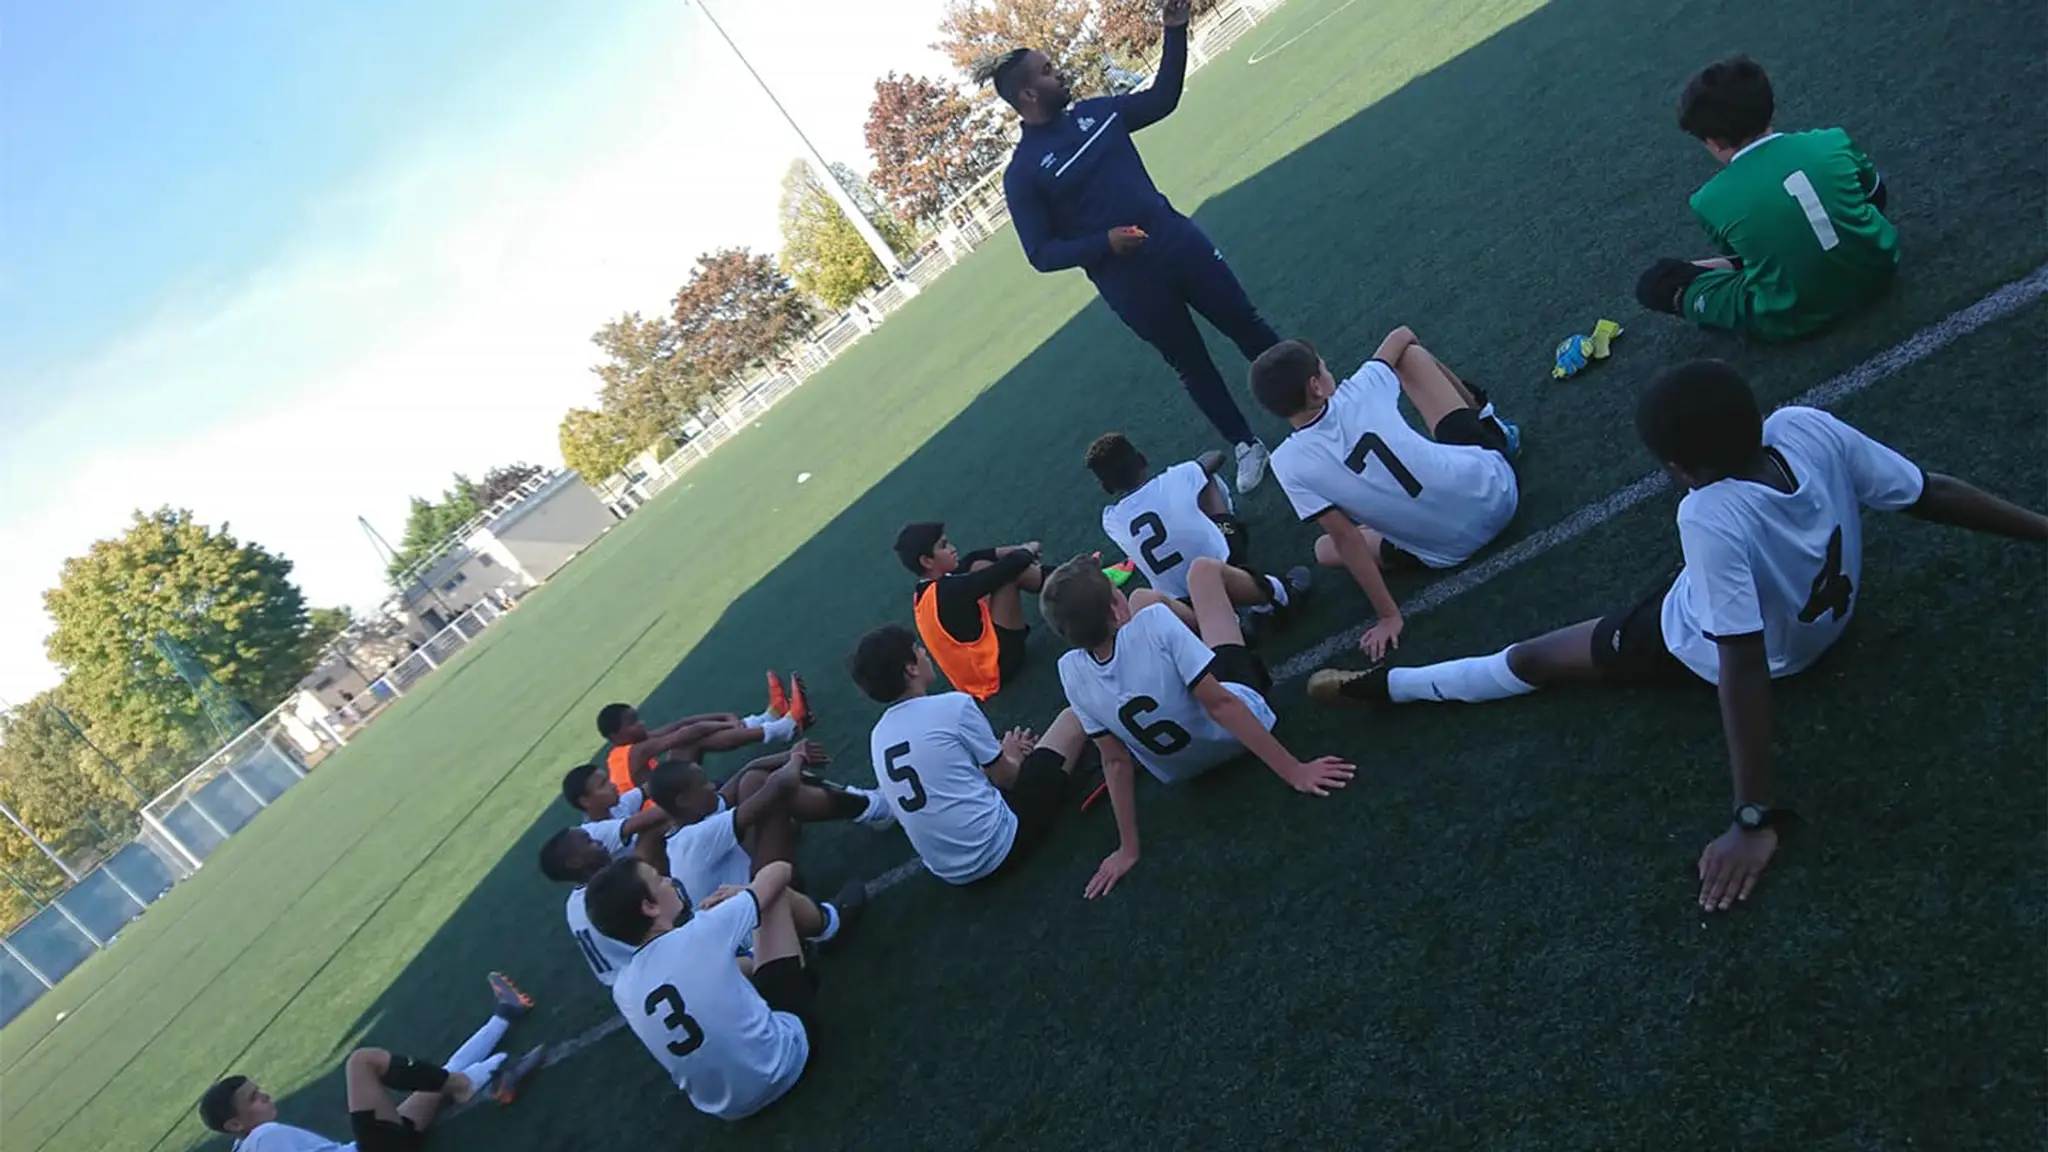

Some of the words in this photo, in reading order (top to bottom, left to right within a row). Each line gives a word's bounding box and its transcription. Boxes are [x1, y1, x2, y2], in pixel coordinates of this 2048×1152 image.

[1783, 169, 1840, 251] 1
[1344, 431, 1424, 500] 7
[1130, 511, 1184, 576] 2
[1797, 524, 1853, 624] 4
[1118, 696, 1191, 756] 6
[885, 741, 927, 812] 5
[645, 984, 704, 1057] 3
